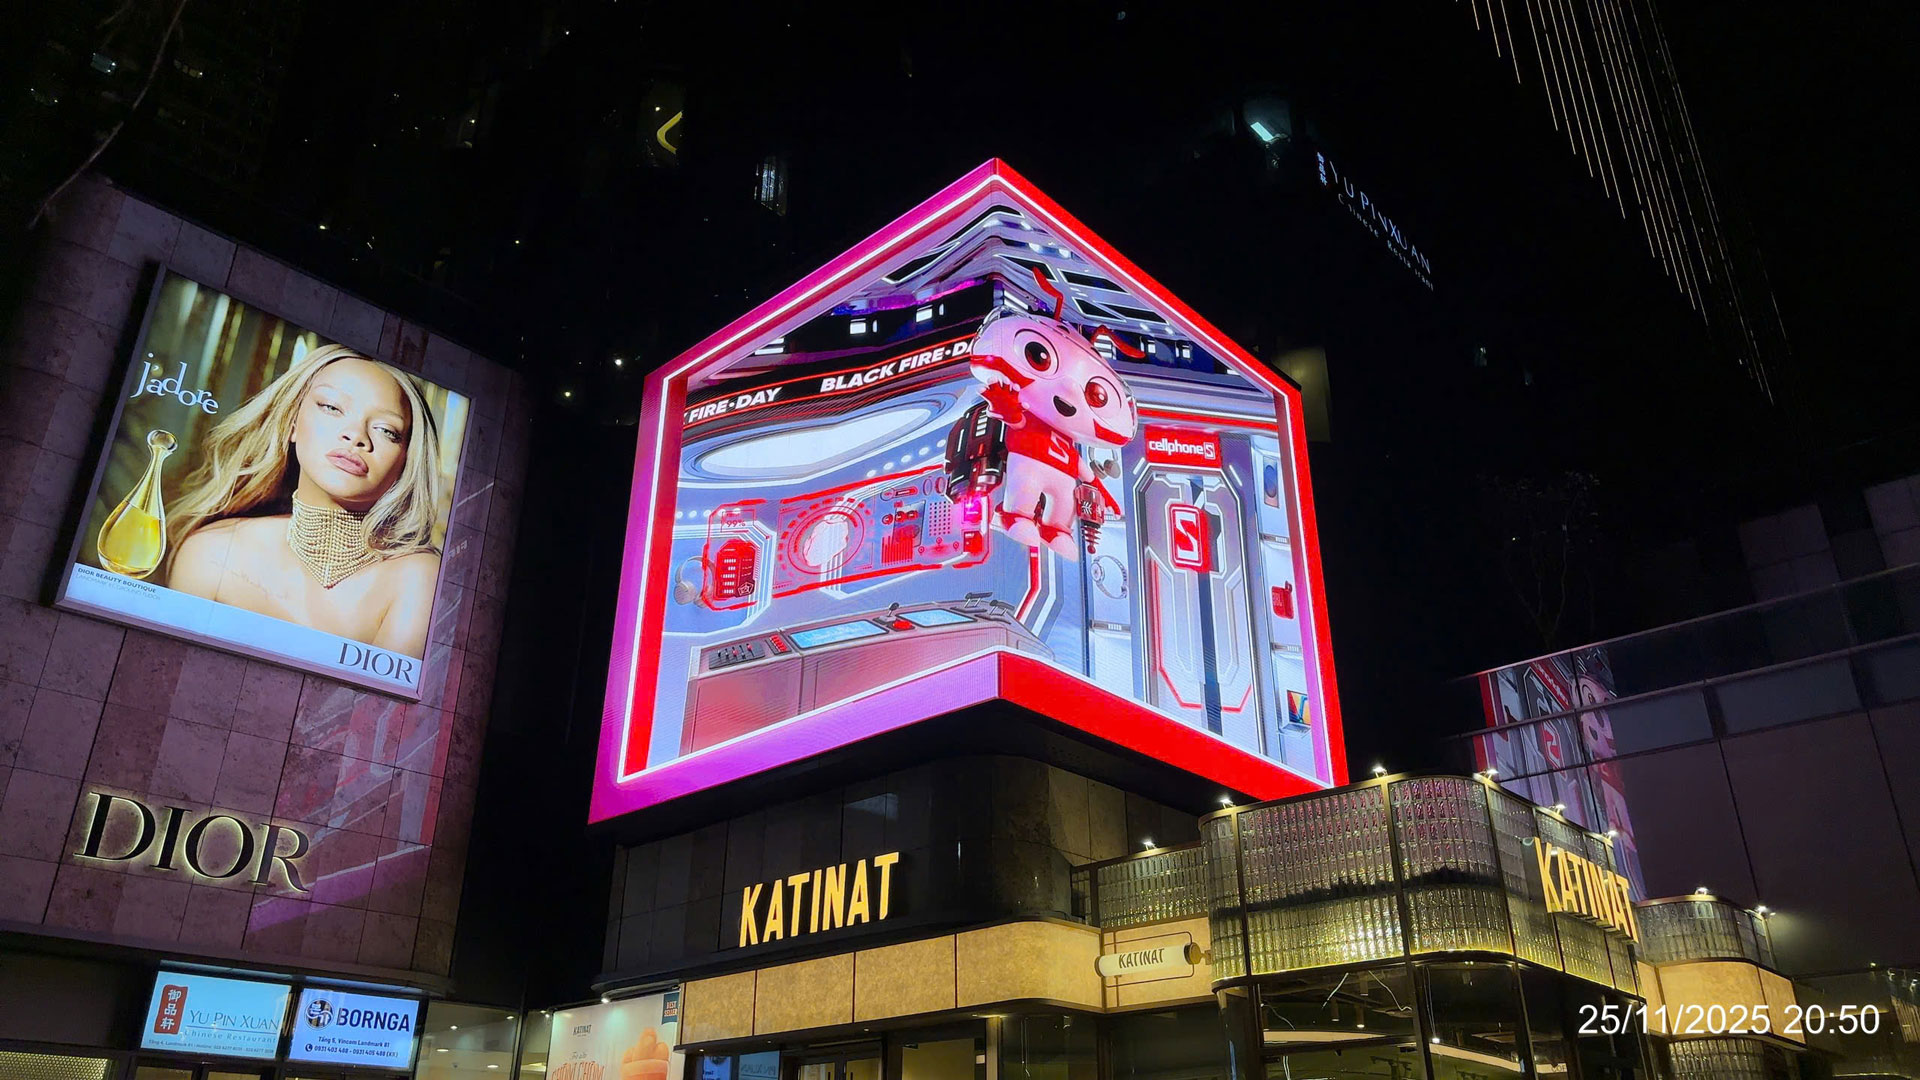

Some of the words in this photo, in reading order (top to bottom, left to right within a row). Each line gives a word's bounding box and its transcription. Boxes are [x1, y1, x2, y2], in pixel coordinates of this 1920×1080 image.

[1389, 219, 1430, 274] XUAN
[820, 361, 894, 393] BLACK
[78, 567, 95, 576] DIOR
[95, 572, 122, 583] BEAUTY
[122, 580, 157, 593] BOUTIQUE
[337, 642, 413, 684] DIOR
[73, 791, 309, 893] DIOR
[739, 851, 899, 948] KATINAT
[1534, 836, 1639, 944] KATINAT
[1118, 948, 1165, 969] KATINAT
[190, 1010, 210, 1024] YU
[214, 1012, 236, 1026] PIN
[239, 1015, 280, 1030] XUAN
[336, 1007, 410, 1032] BORNGA
[573, 1024, 592, 1036] KATINAT
[226, 1033, 277, 1044] Restaurant
